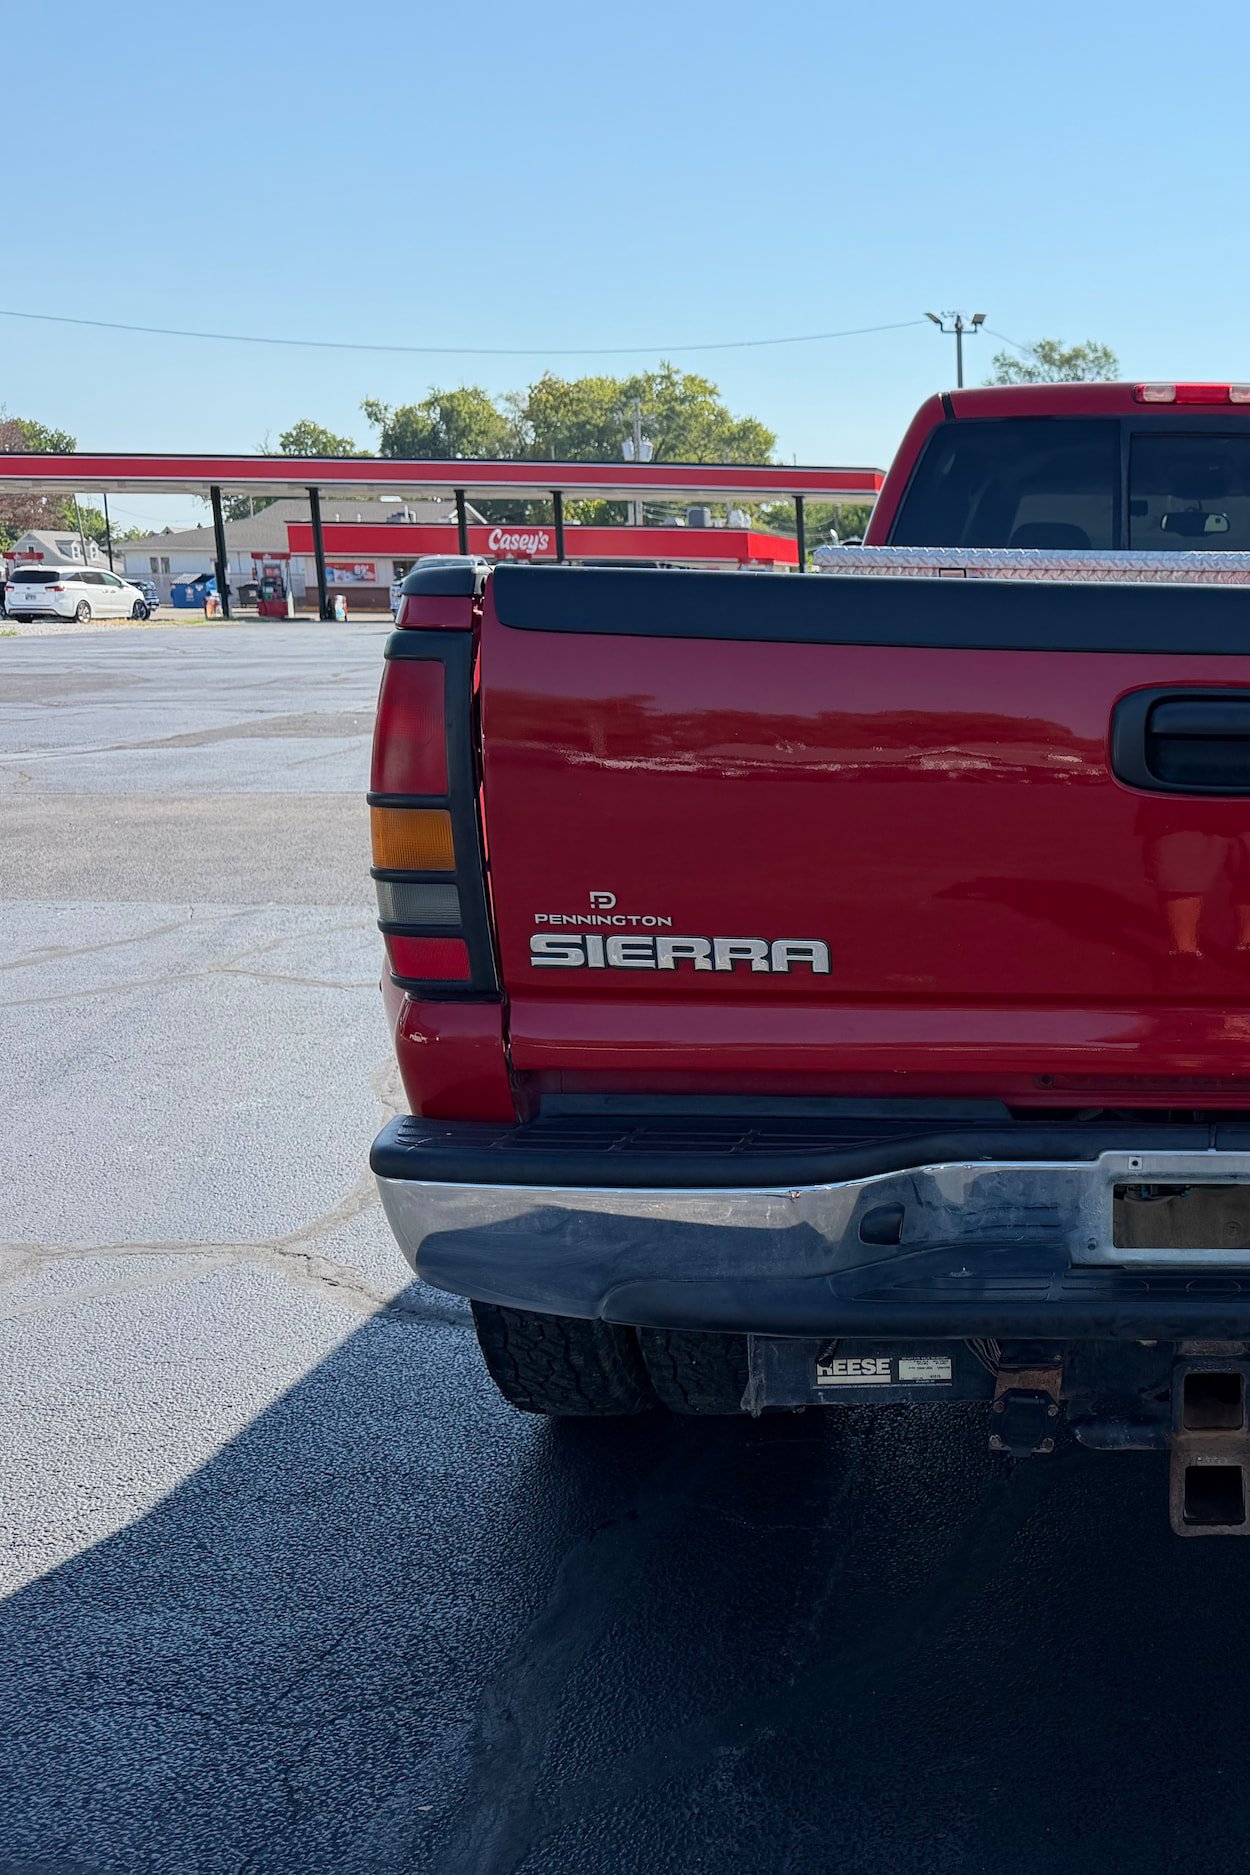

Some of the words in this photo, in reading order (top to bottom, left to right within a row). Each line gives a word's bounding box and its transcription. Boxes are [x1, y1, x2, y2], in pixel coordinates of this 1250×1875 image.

[488, 528, 549, 554] Casey's
[534, 913, 673, 927] PENNINGTON
[529, 933, 832, 974] SIERRA
